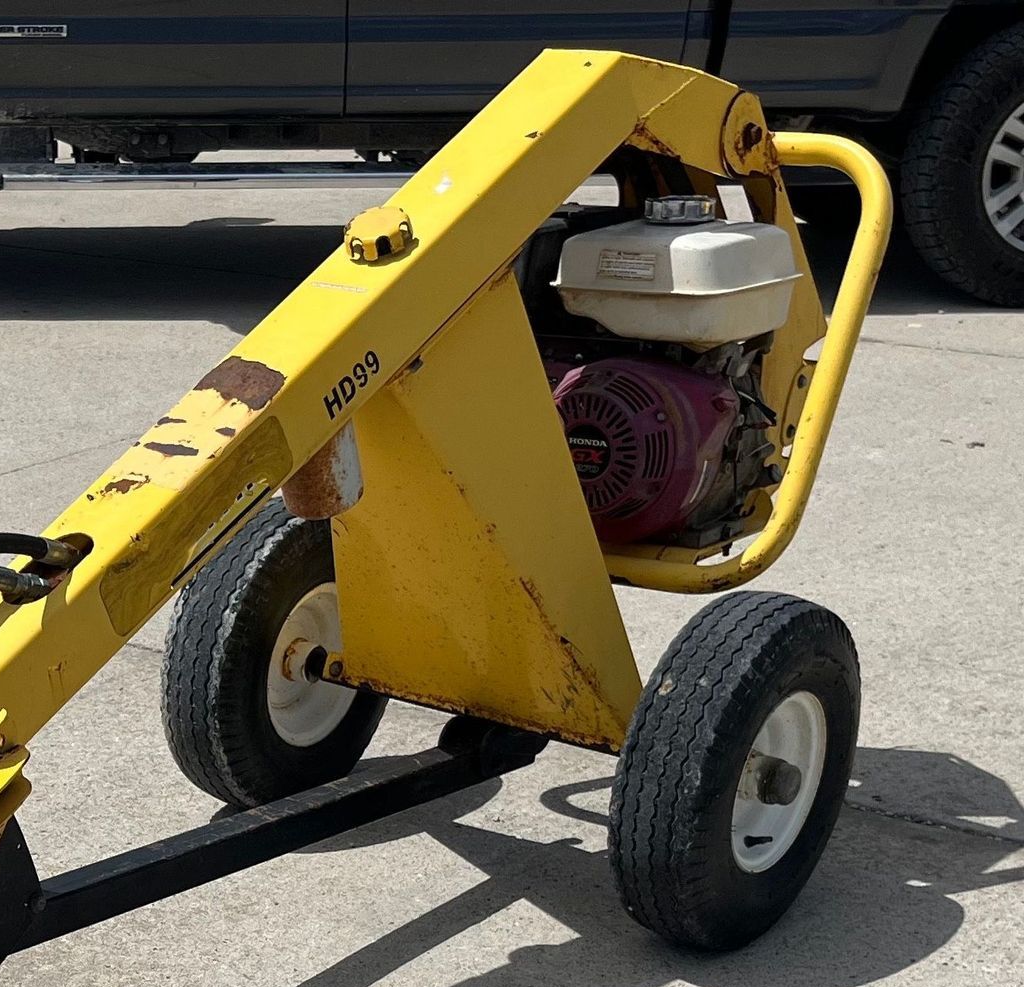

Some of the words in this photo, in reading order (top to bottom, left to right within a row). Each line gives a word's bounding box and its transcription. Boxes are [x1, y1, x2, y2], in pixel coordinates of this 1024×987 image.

[323, 351, 380, 421] HD99
[569, 437, 608, 448] HONDA
[573, 449, 604, 464] GX
